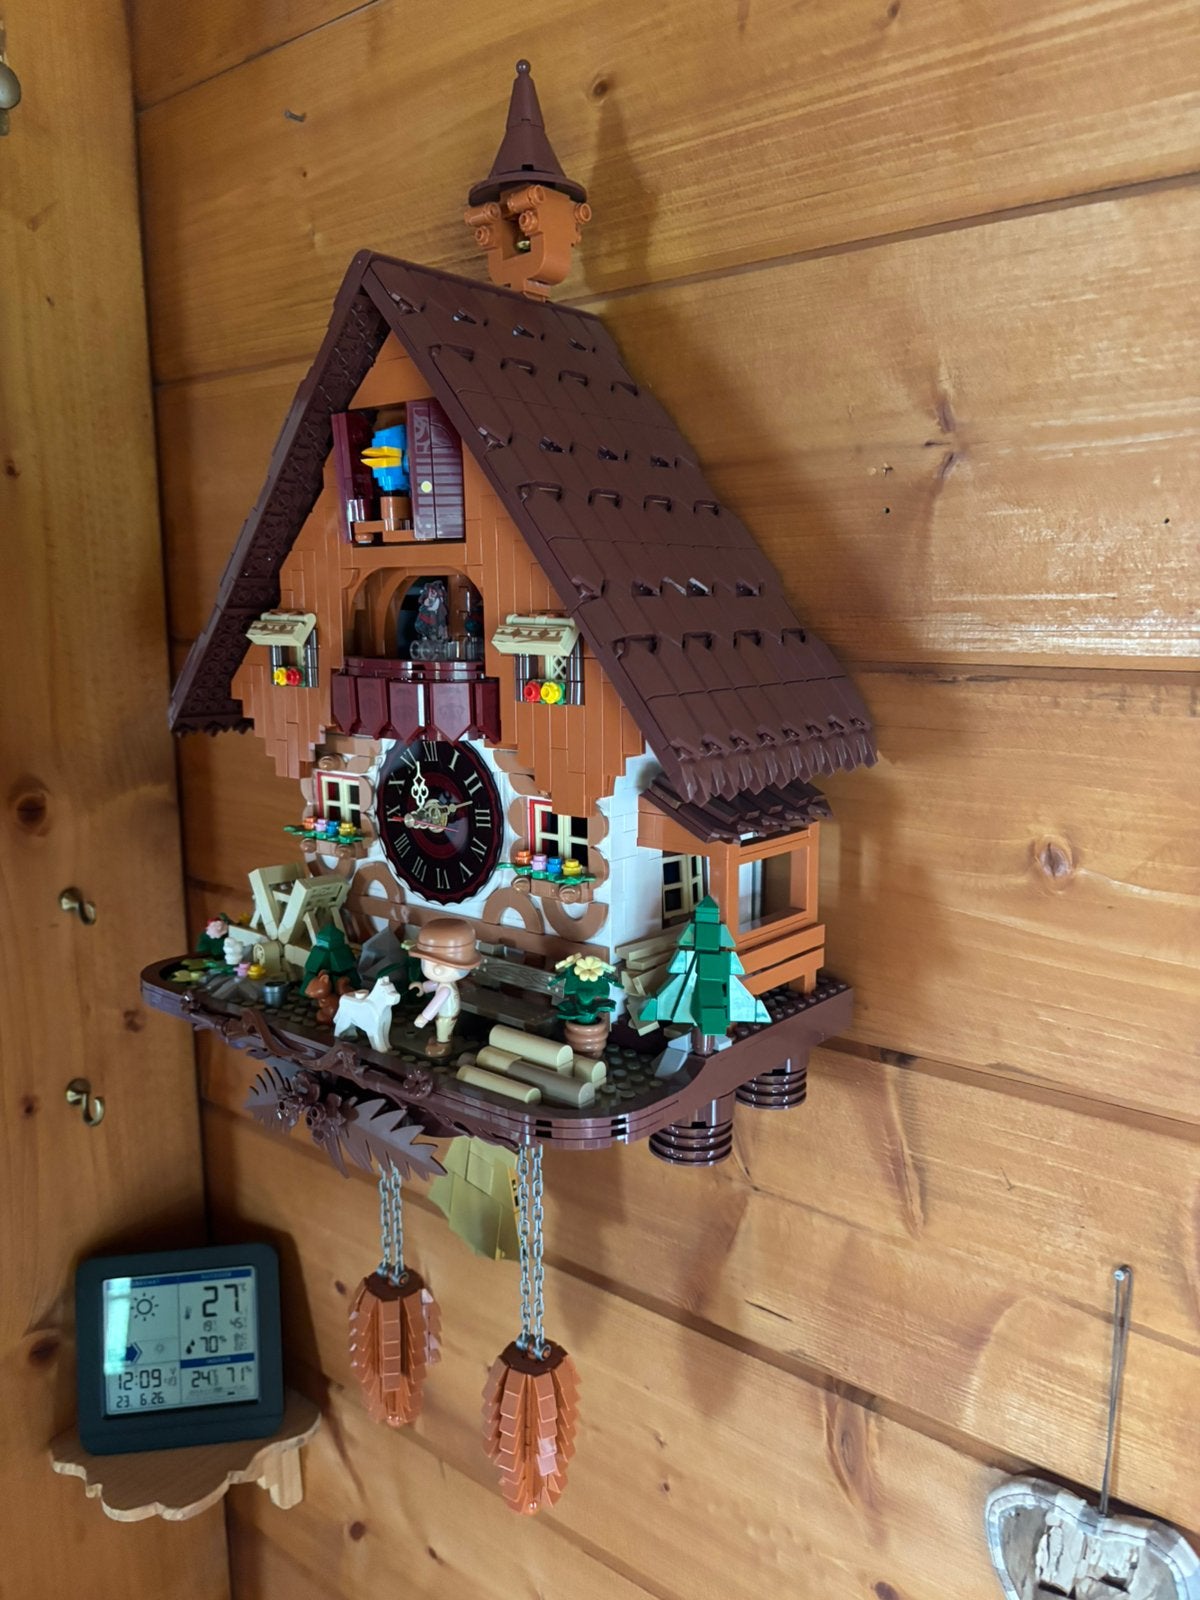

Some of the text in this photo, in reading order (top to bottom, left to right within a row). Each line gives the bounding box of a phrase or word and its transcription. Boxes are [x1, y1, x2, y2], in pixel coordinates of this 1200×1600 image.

[464, 771, 483, 796] II
[476, 809, 492, 829] III
[471, 838, 487, 862] IV
[412, 857, 428, 882] VII
[437, 869, 451, 890] VI
[460, 862, 473, 883] V
[118, 1368, 162, 1391] 12:09
